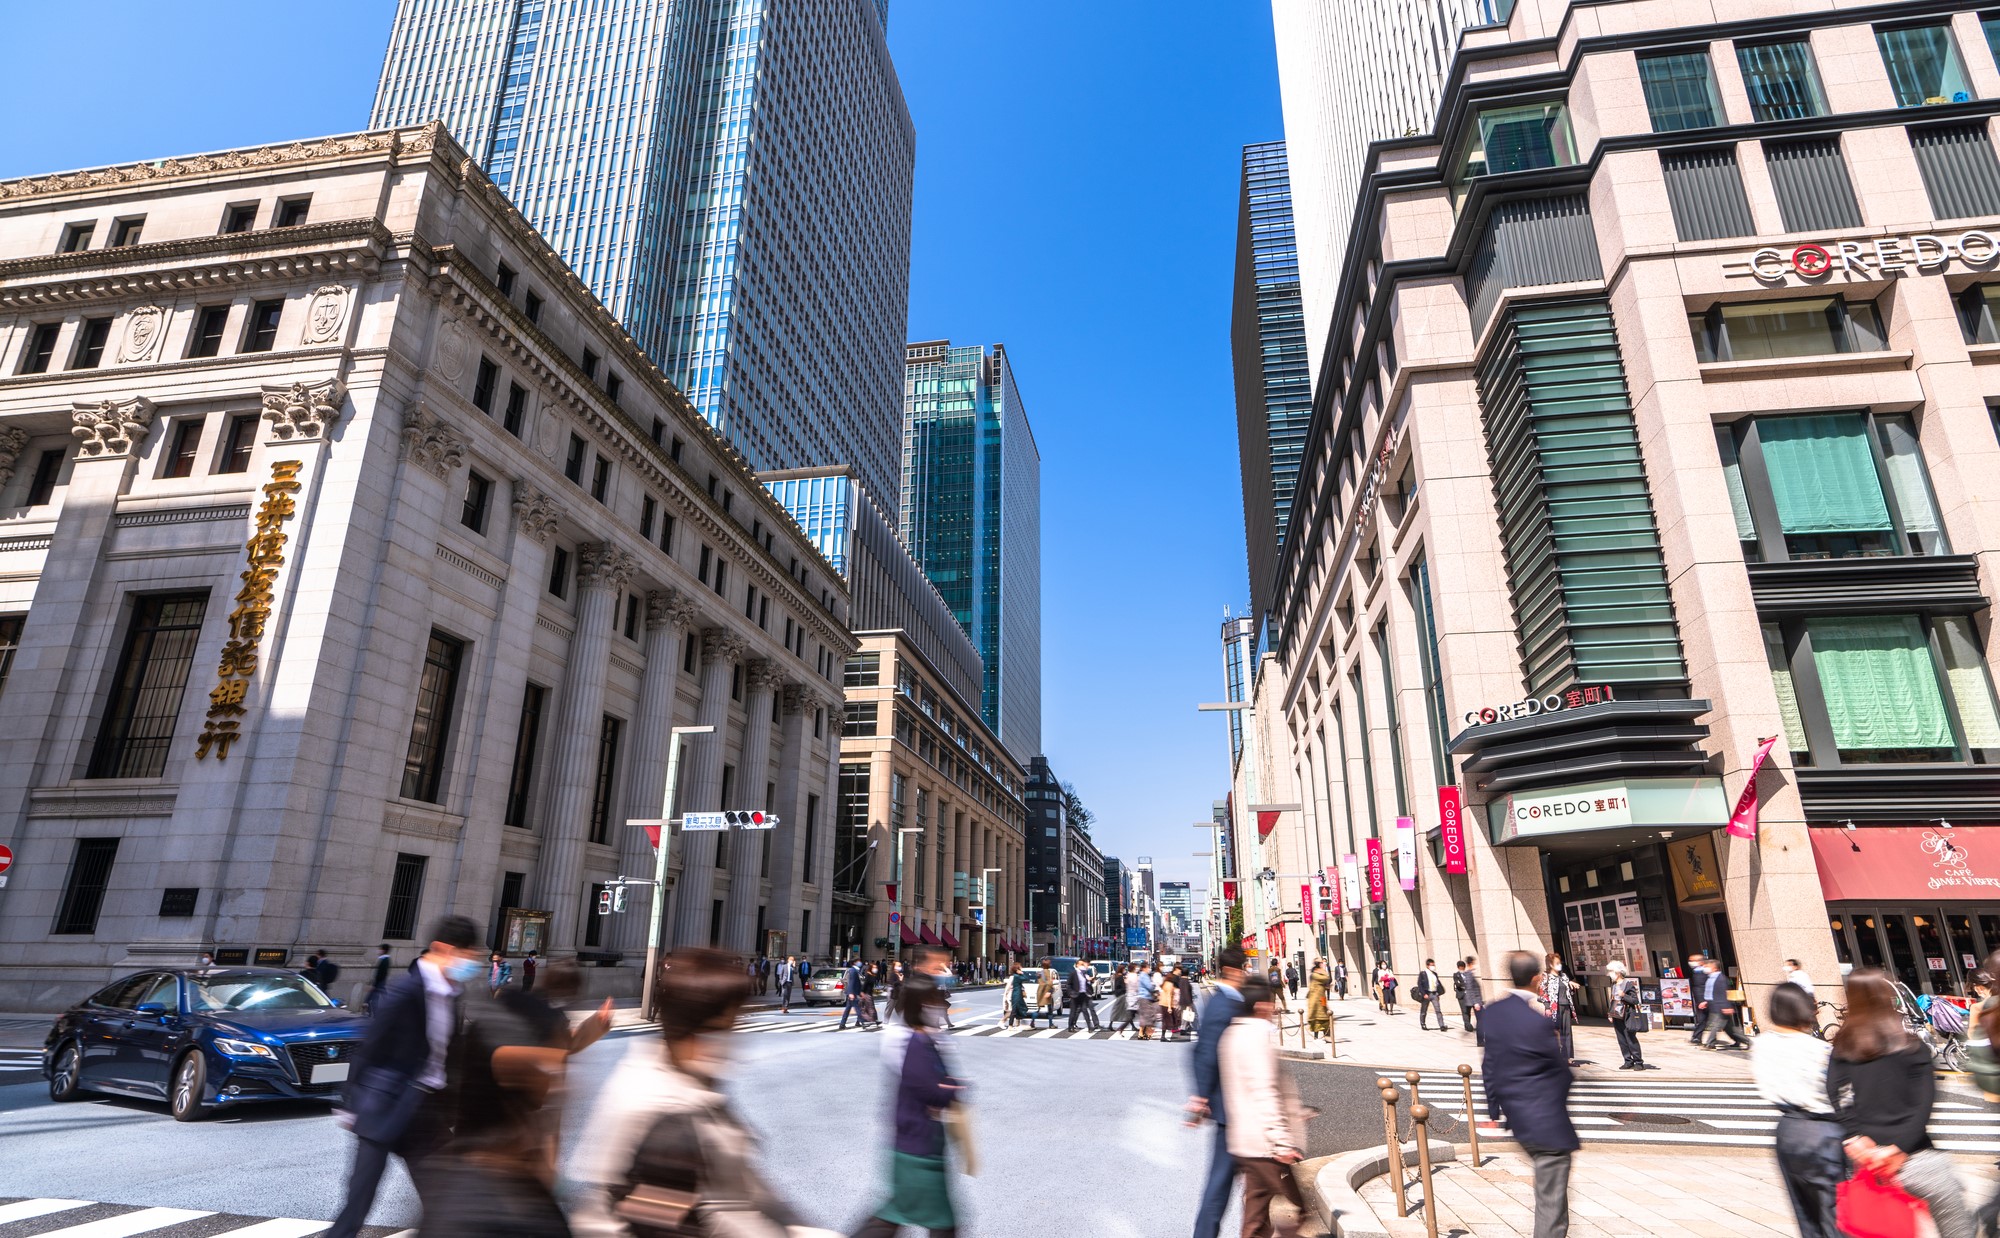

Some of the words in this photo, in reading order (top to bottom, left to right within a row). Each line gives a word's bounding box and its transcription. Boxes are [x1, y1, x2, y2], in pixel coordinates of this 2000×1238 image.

[1750, 230, 1999, 278] COREDO
[194, 459, 303, 760] 三井住友信託銀行
[1464, 694, 1562, 726] COREDO
[1566, 684, 1615, 708] 室町1
[1445, 800, 1459, 854] COREDO
[1516, 800, 1591, 821] COREDO
[1594, 797, 1627, 813] 室町1
[1370, 848, 1382, 888] COREDO
